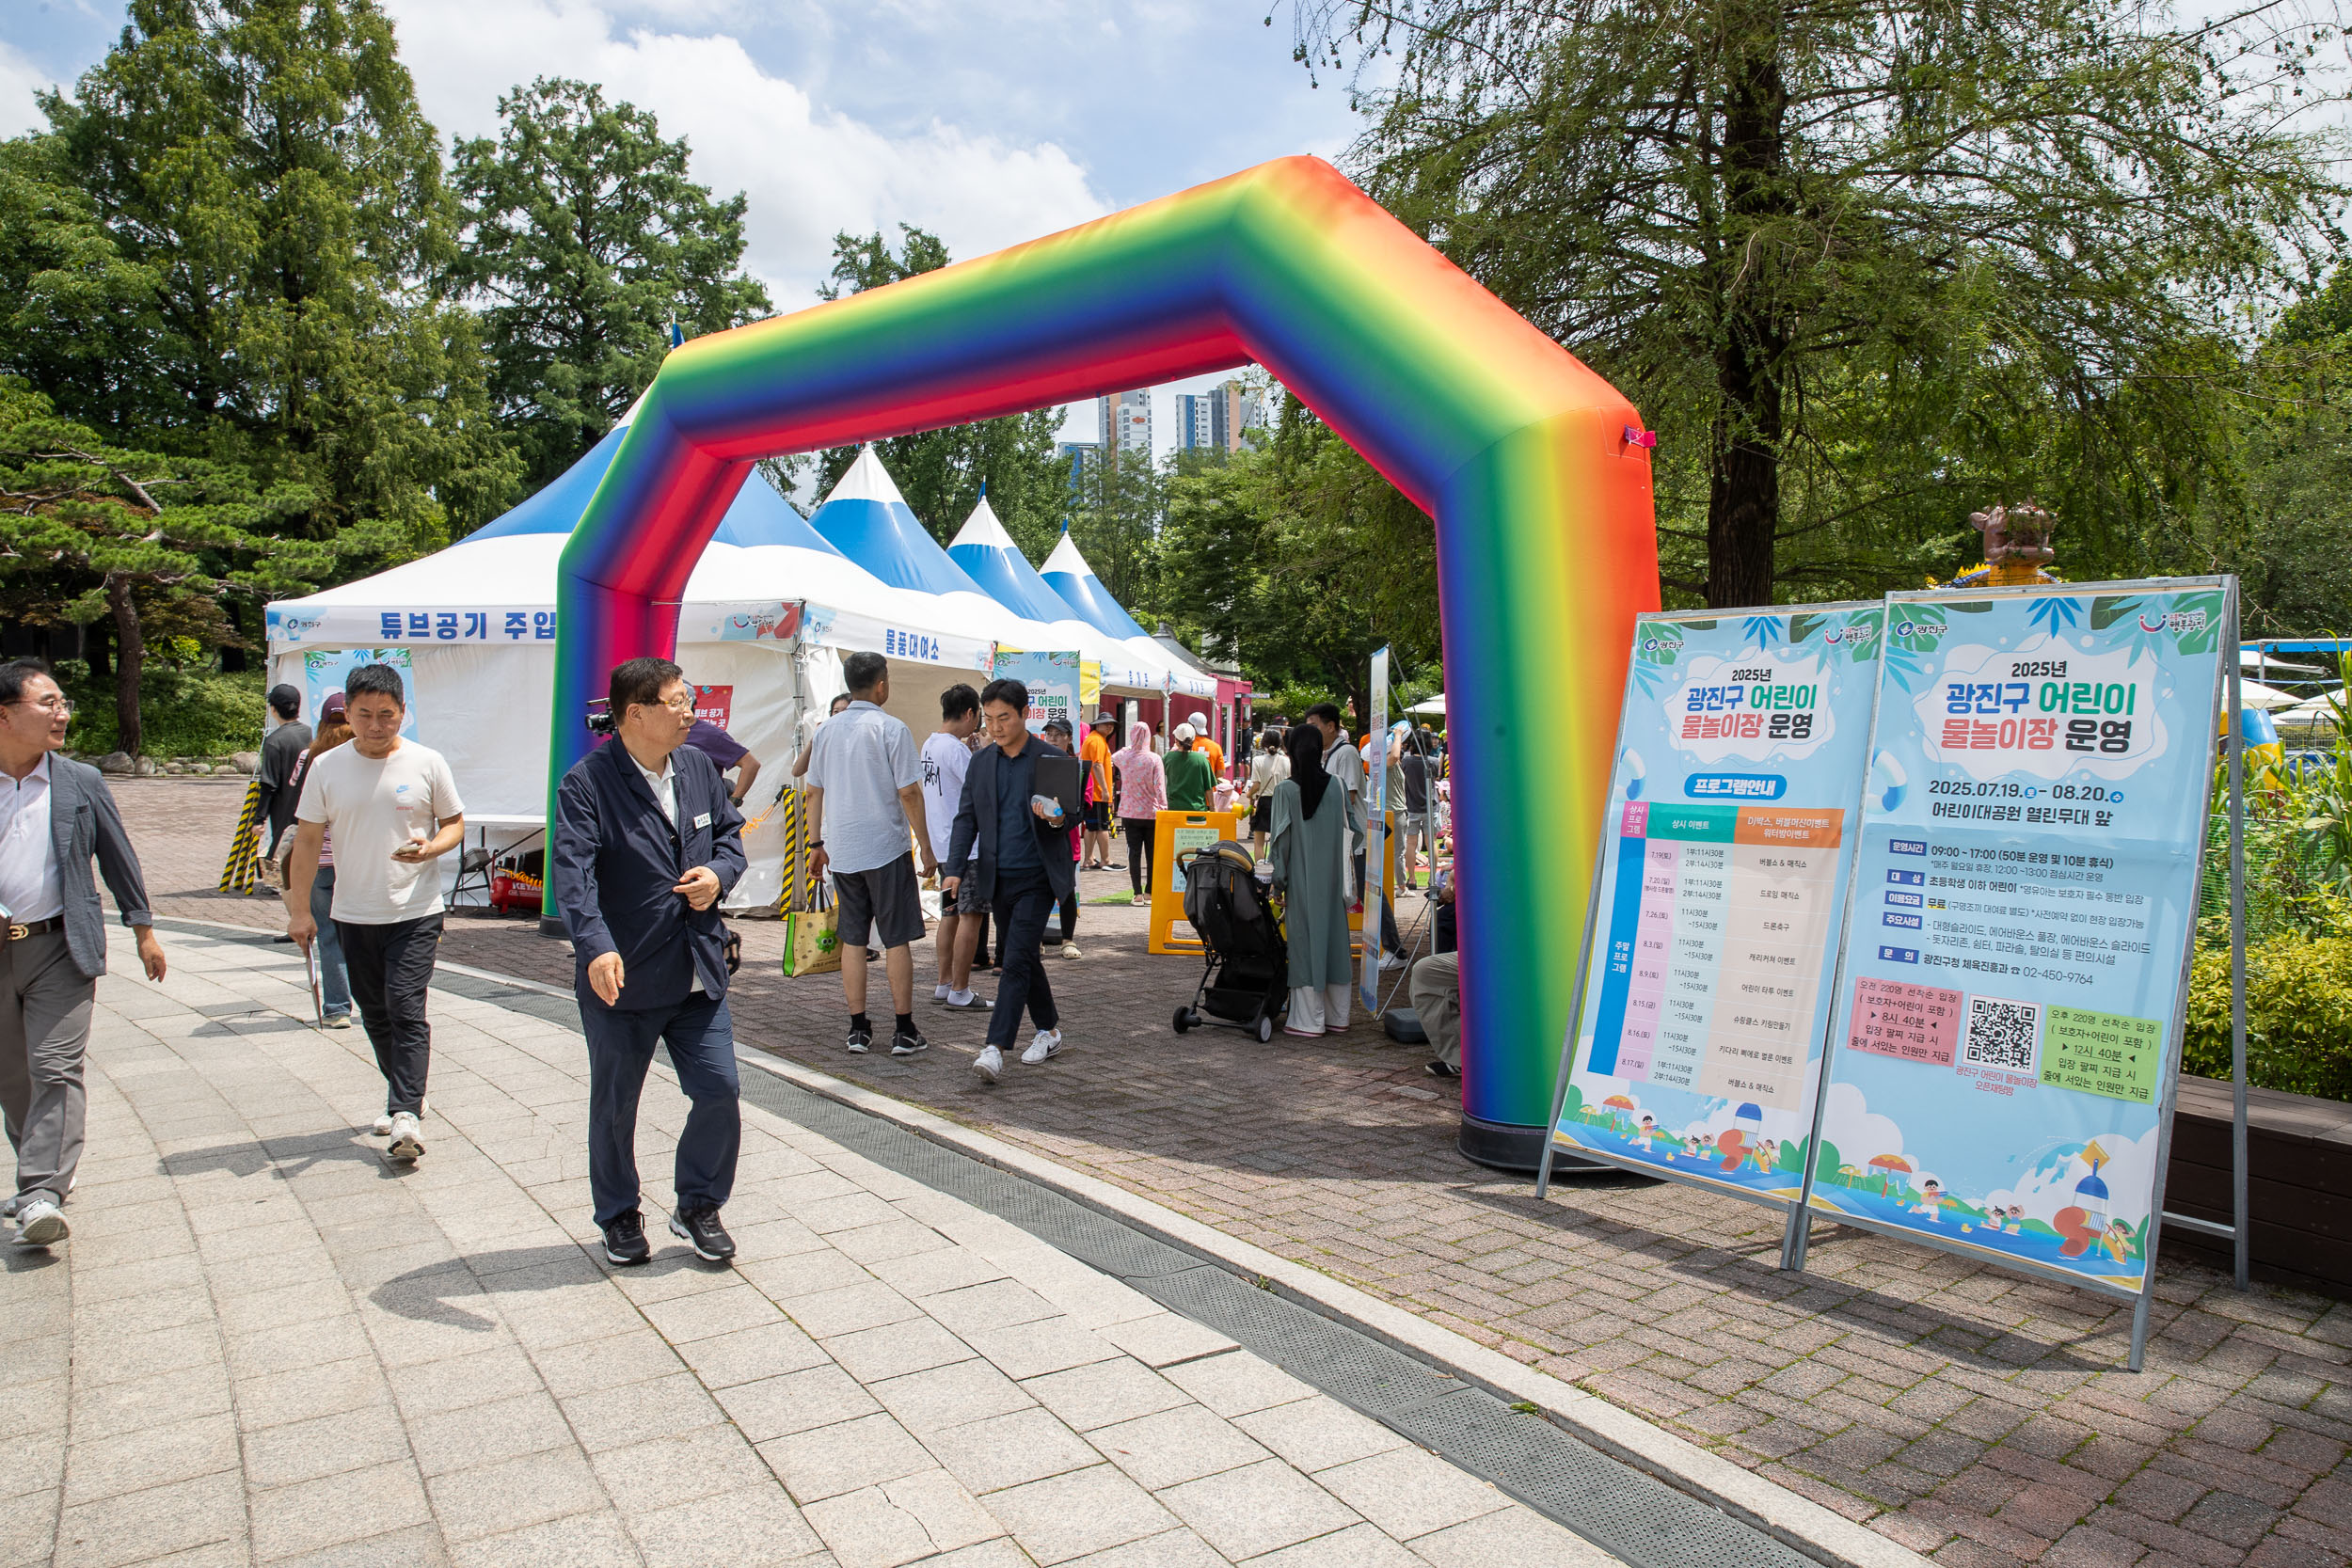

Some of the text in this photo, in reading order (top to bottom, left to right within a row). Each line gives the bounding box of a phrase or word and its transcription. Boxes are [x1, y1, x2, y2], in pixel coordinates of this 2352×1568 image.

[380, 611, 558, 640] 튜브공기 주입
[1916, 624, 1948, 635] 광진구
[2169, 618, 2204, 631] 행복광진
[886, 628, 939, 660] 물품대여소
[1660, 641, 1684, 650] 광진구
[1732, 668, 1772, 682] 2025년
[2011, 660, 2067, 678] 2025년
[1038, 696, 1067, 707] 어린이
[1687, 684, 1817, 711] 광진구 어린이
[1947, 682, 2136, 715] 광진구 어린이
[708, 708, 723, 718] 공기
[1048, 708, 1067, 720] 운영
[1681, 713, 1813, 739] 물놀이장 운영
[1941, 718, 2132, 753] 물놀이장 운영
[1693, 778, 1776, 796] 프로그램안내
[1629, 805, 1645, 815] 상시
[1932, 802, 2114, 827] 어린이대공원 열린무대 앞
[1628, 815, 1642, 824] 프로
[1672, 819, 1709, 830] 상시 이벤트
[1775, 817, 1830, 828] 버블머신이벤트
[1626, 825, 1641, 834] 그램
[1763, 828, 1810, 839] 워터밤이벤트
[1686, 847, 1724, 858] 1부:11시30분
[1893, 841, 1924, 853] 운영시간
[1685, 859, 1724, 870] 2부:14시30분
[1759, 858, 1807, 868] 버블쇼 매직쇼
[1931, 846, 2114, 869] 09:00 17:00 (50분 운영 및 10분 휴식)
[1950, 861, 2104, 882] 월요일 12:00 ~13:00 점심시간 운영
[1684, 878, 1723, 889] 1부:11시30분
[1929, 876, 1965, 889] 초등학생
[1968, 879, 1986, 891] 이하
[1989, 880, 2017, 894] 어린이
[2058, 889, 2084, 900] 보호자
[2086, 891, 2104, 901] 필수
[2106, 893, 2123, 904] 동반
[2125, 894, 2144, 905] 입장
[1682, 890, 1722, 900] 2부:14시30분
[1759, 890, 1800, 900] 드로잉 매직쇼
[1888, 893, 1920, 906] 이용요금
[1681, 908, 1708, 918] 11시30분
[1928, 897, 1947, 909] 무료
[1983, 904, 2007, 915] 대여료
[2010, 907, 2029, 918] 별도)
[2070, 912, 2087, 924] 없이
[2090, 915, 2106, 926] 현장
[2108, 916, 2144, 929] 입장가능
[1762, 921, 1790, 932] 드론축구
[1886, 914, 1919, 927] 주요시설
[1678, 939, 1705, 949] 11시30분
[1932, 920, 2151, 954] 대형슬라이드, 에어바운스 풀장, 에어바운스 슬라이드
[1614, 941, 1630, 952] 주말
[1932, 934, 2116, 966] 돗자리존, 쉼터, 파라솔, 탈의실 등 편의시설
[1613, 952, 1629, 962] 프로
[1777, 956, 1796, 966] 이벤트
[1612, 962, 1628, 974] 그램
[1674, 969, 1700, 979] 11시30분
[1923, 954, 2093, 985] 광진구청 체육진흥과 02-450-9764
[1741, 983, 1794, 997] 어린이 타투 이벤트
[1859, 980, 1957, 1004] 오전 220명 선착순 입장
[1669, 999, 1695, 1010] 11시30분
[1866, 995, 1946, 1017] 보호자+어린이 포함
[1882, 1012, 1925, 1028] 8시 40분
[2051, 1009, 2155, 1035] 오후 220명 선착순 입장
[1663, 1031, 1689, 1042] 11시30분
[1866, 1024, 1939, 1045] 입장 팔찌 지급 시
[2058, 1025, 2143, 1049] 보호자+어린이 포함
[1719, 1045, 1792, 1064] 키다리 이벤트
[1851, 1036, 1950, 1063] 줄에 서있는 인원만 지급
[2074, 1044, 2122, 1063] 12시 40분
[1657, 1060, 1693, 1074] 1부:11시30분
[2058, 1057, 2136, 1081] 입장 팔찌 지급 시
[1654, 1072, 1691, 1086] 2부:14시30분
[1956, 1065, 2039, 1089] 광진구 어린이 물놀이장
[1727, 1078, 1774, 1094] 버블쇼 매직쇼
[1975, 1080, 2014, 1097] 오픈채팅방
[2042, 1069, 2149, 1100] 줄에 서있는 인원만 지급
